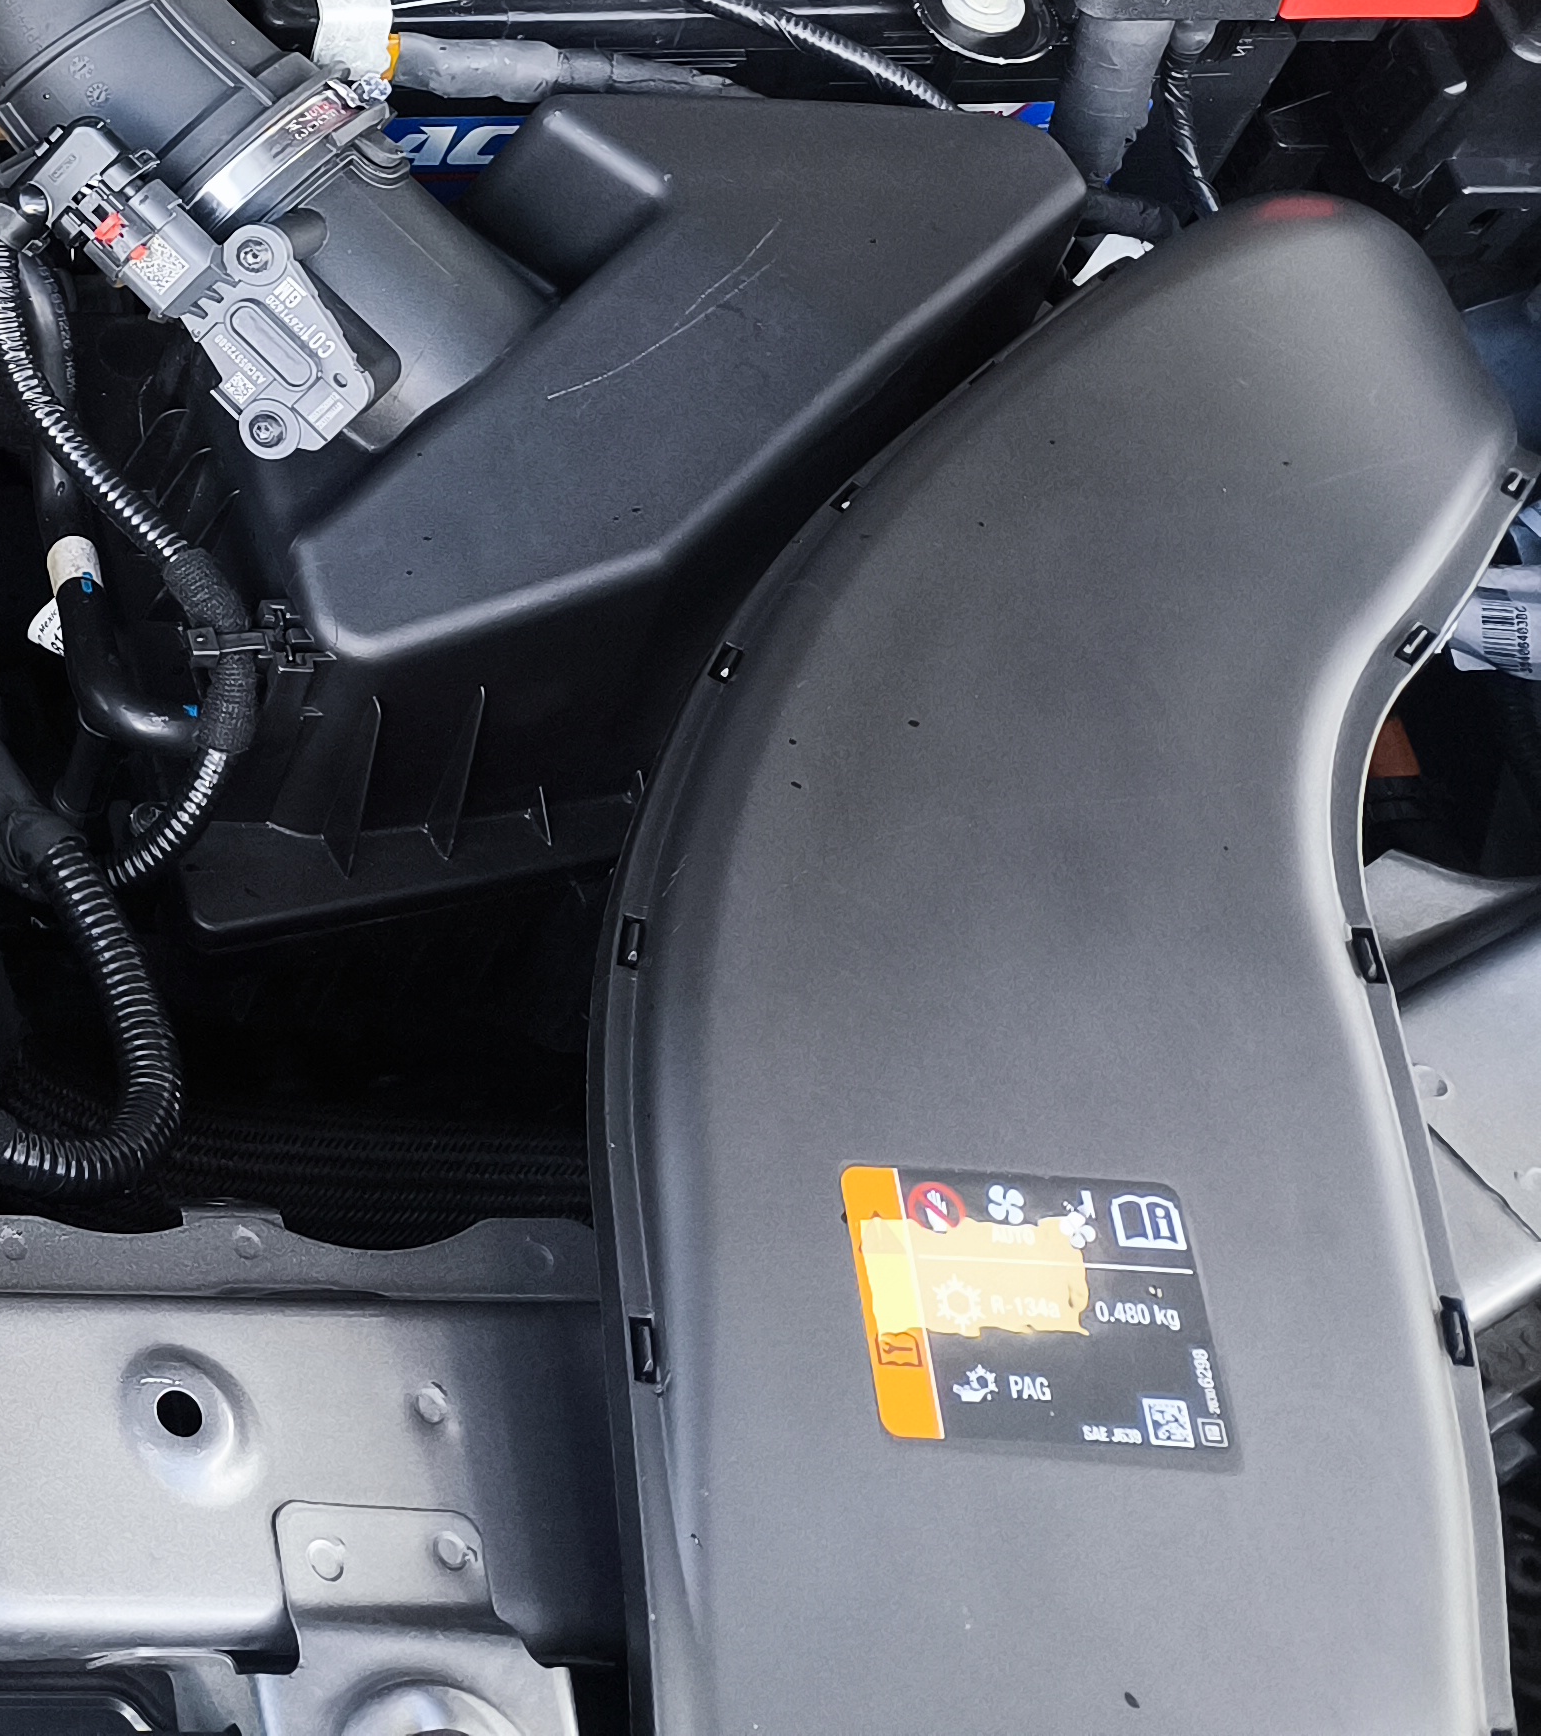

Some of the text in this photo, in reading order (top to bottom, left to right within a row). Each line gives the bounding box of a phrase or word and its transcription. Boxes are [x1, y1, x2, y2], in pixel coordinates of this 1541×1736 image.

[273, 277, 306, 309] GM
[991, 1226, 1036, 1246] AUTO
[990, 1294, 1181, 1331] R-134a 0.480 kg
[1008, 1375, 1052, 1401] PAG
[1082, 1425, 1110, 1442] SAE
